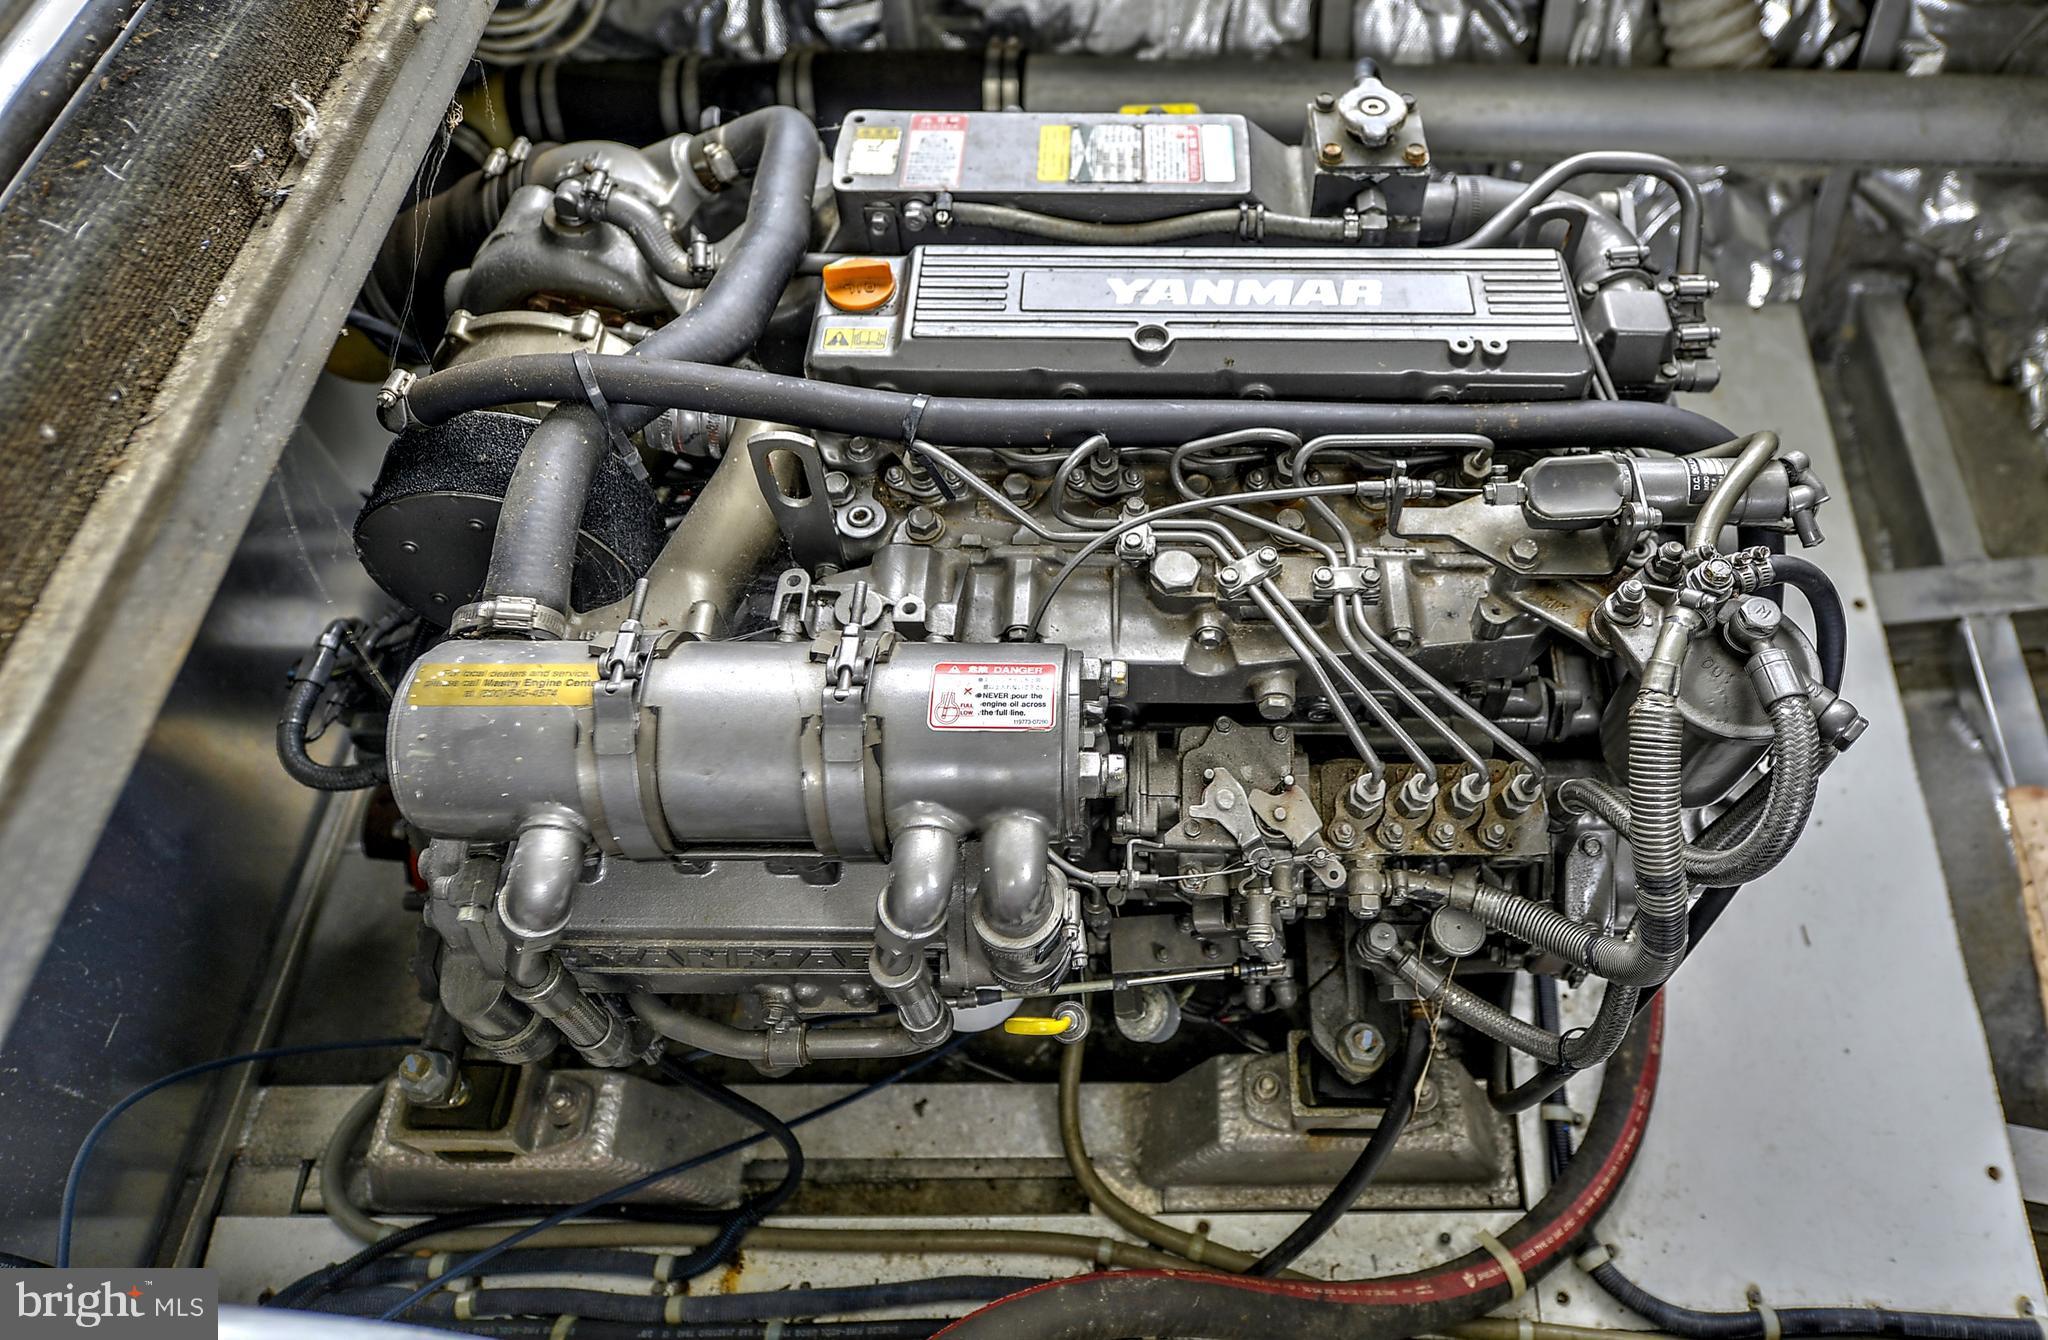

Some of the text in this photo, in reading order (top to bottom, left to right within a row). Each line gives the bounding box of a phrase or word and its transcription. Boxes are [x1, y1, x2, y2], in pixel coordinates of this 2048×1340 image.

[1106, 278, 1383, 306] YANMAR
[993, 665, 1043, 674] DANGER
[524, 678, 562, 688] Engine
